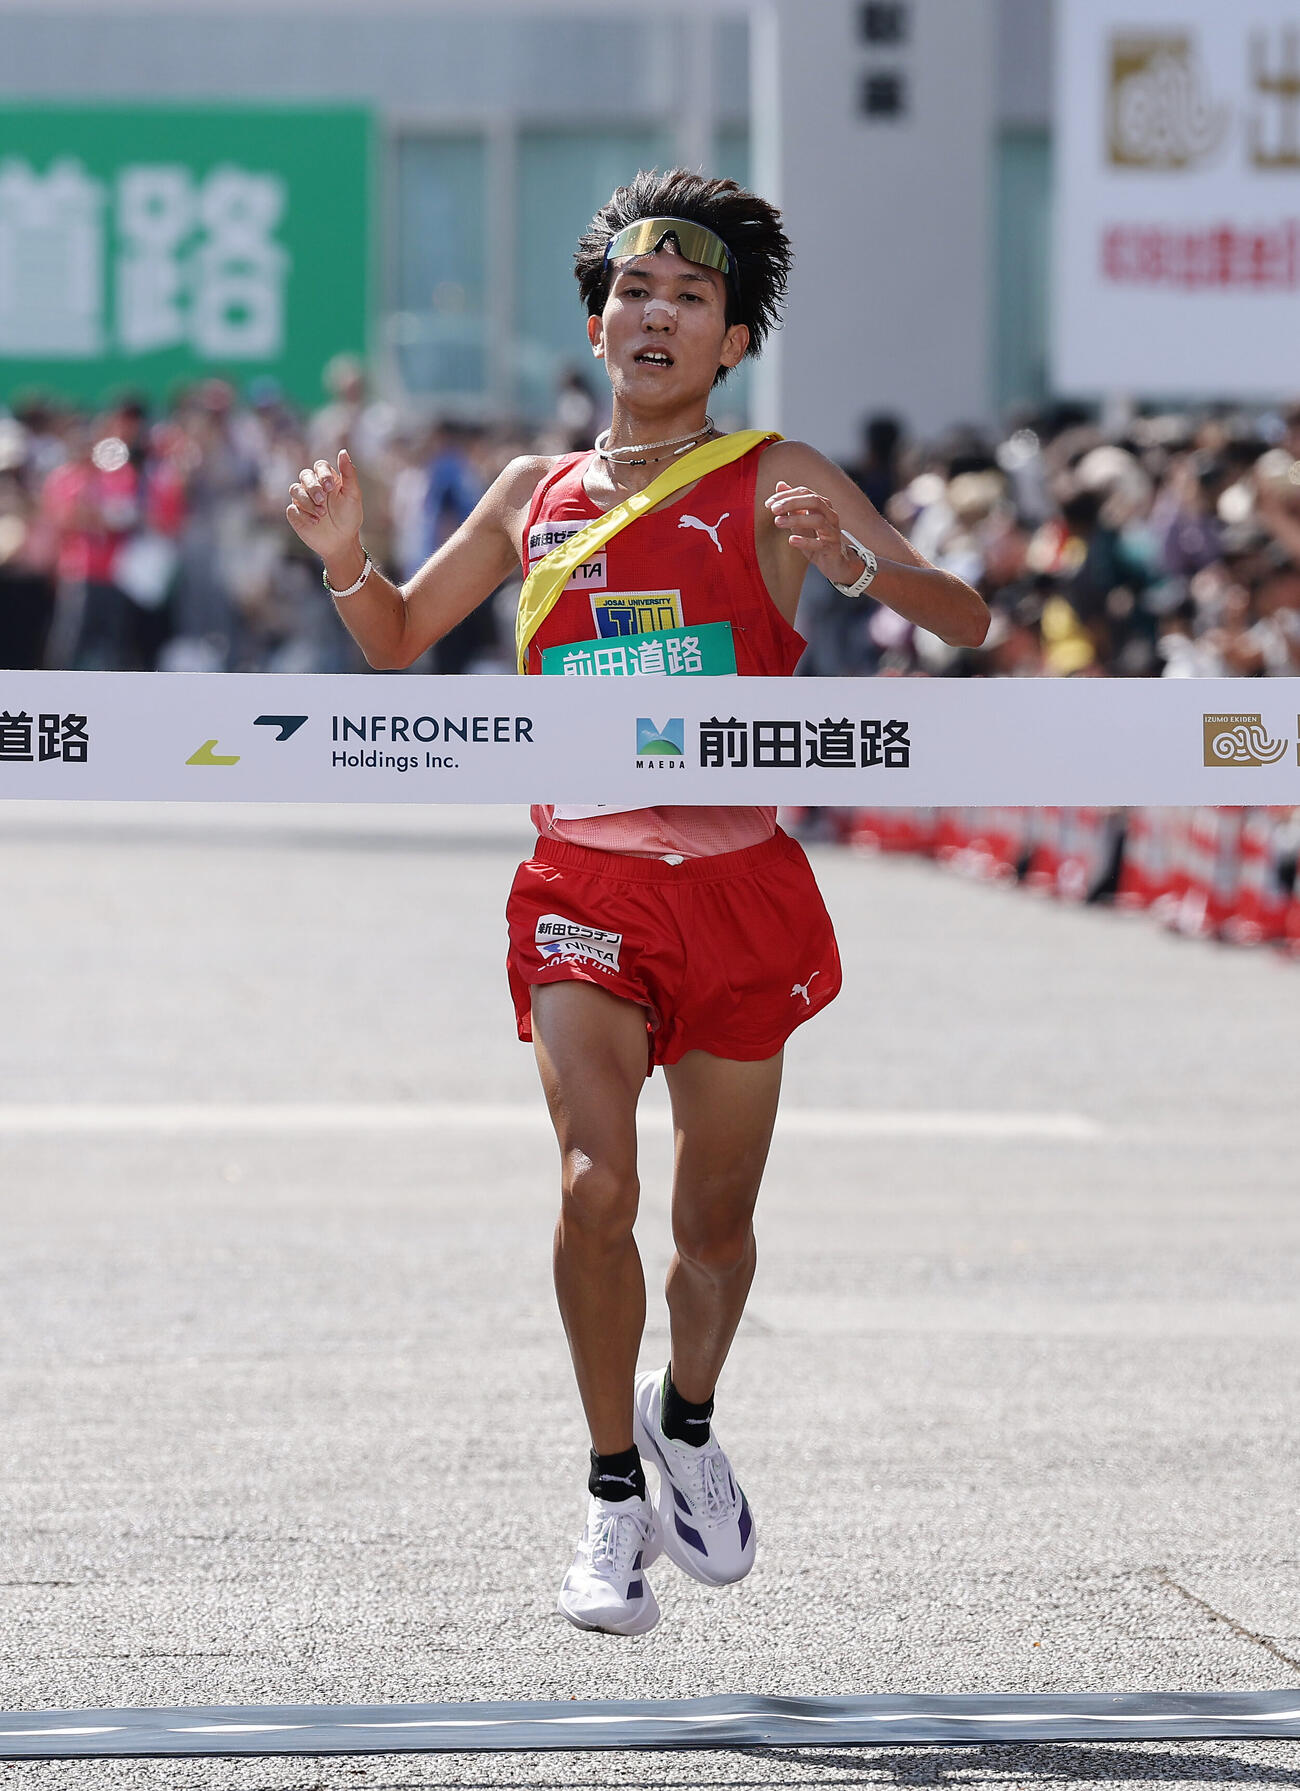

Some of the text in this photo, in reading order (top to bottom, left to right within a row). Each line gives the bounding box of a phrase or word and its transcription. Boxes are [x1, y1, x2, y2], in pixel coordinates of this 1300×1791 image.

[572, 562, 602, 579] TTA
[628, 598, 671, 606] UNIVERSITY
[563, 636, 702, 676] 前田道路
[0, 710, 89, 762] 道路
[332, 716, 534, 742] INFRONEER
[699, 716, 910, 768] 前田道路
[332, 750, 459, 772] Holdings Inc.
[636, 760, 685, 769] MAEDA
[565, 941, 615, 964] NITTA
